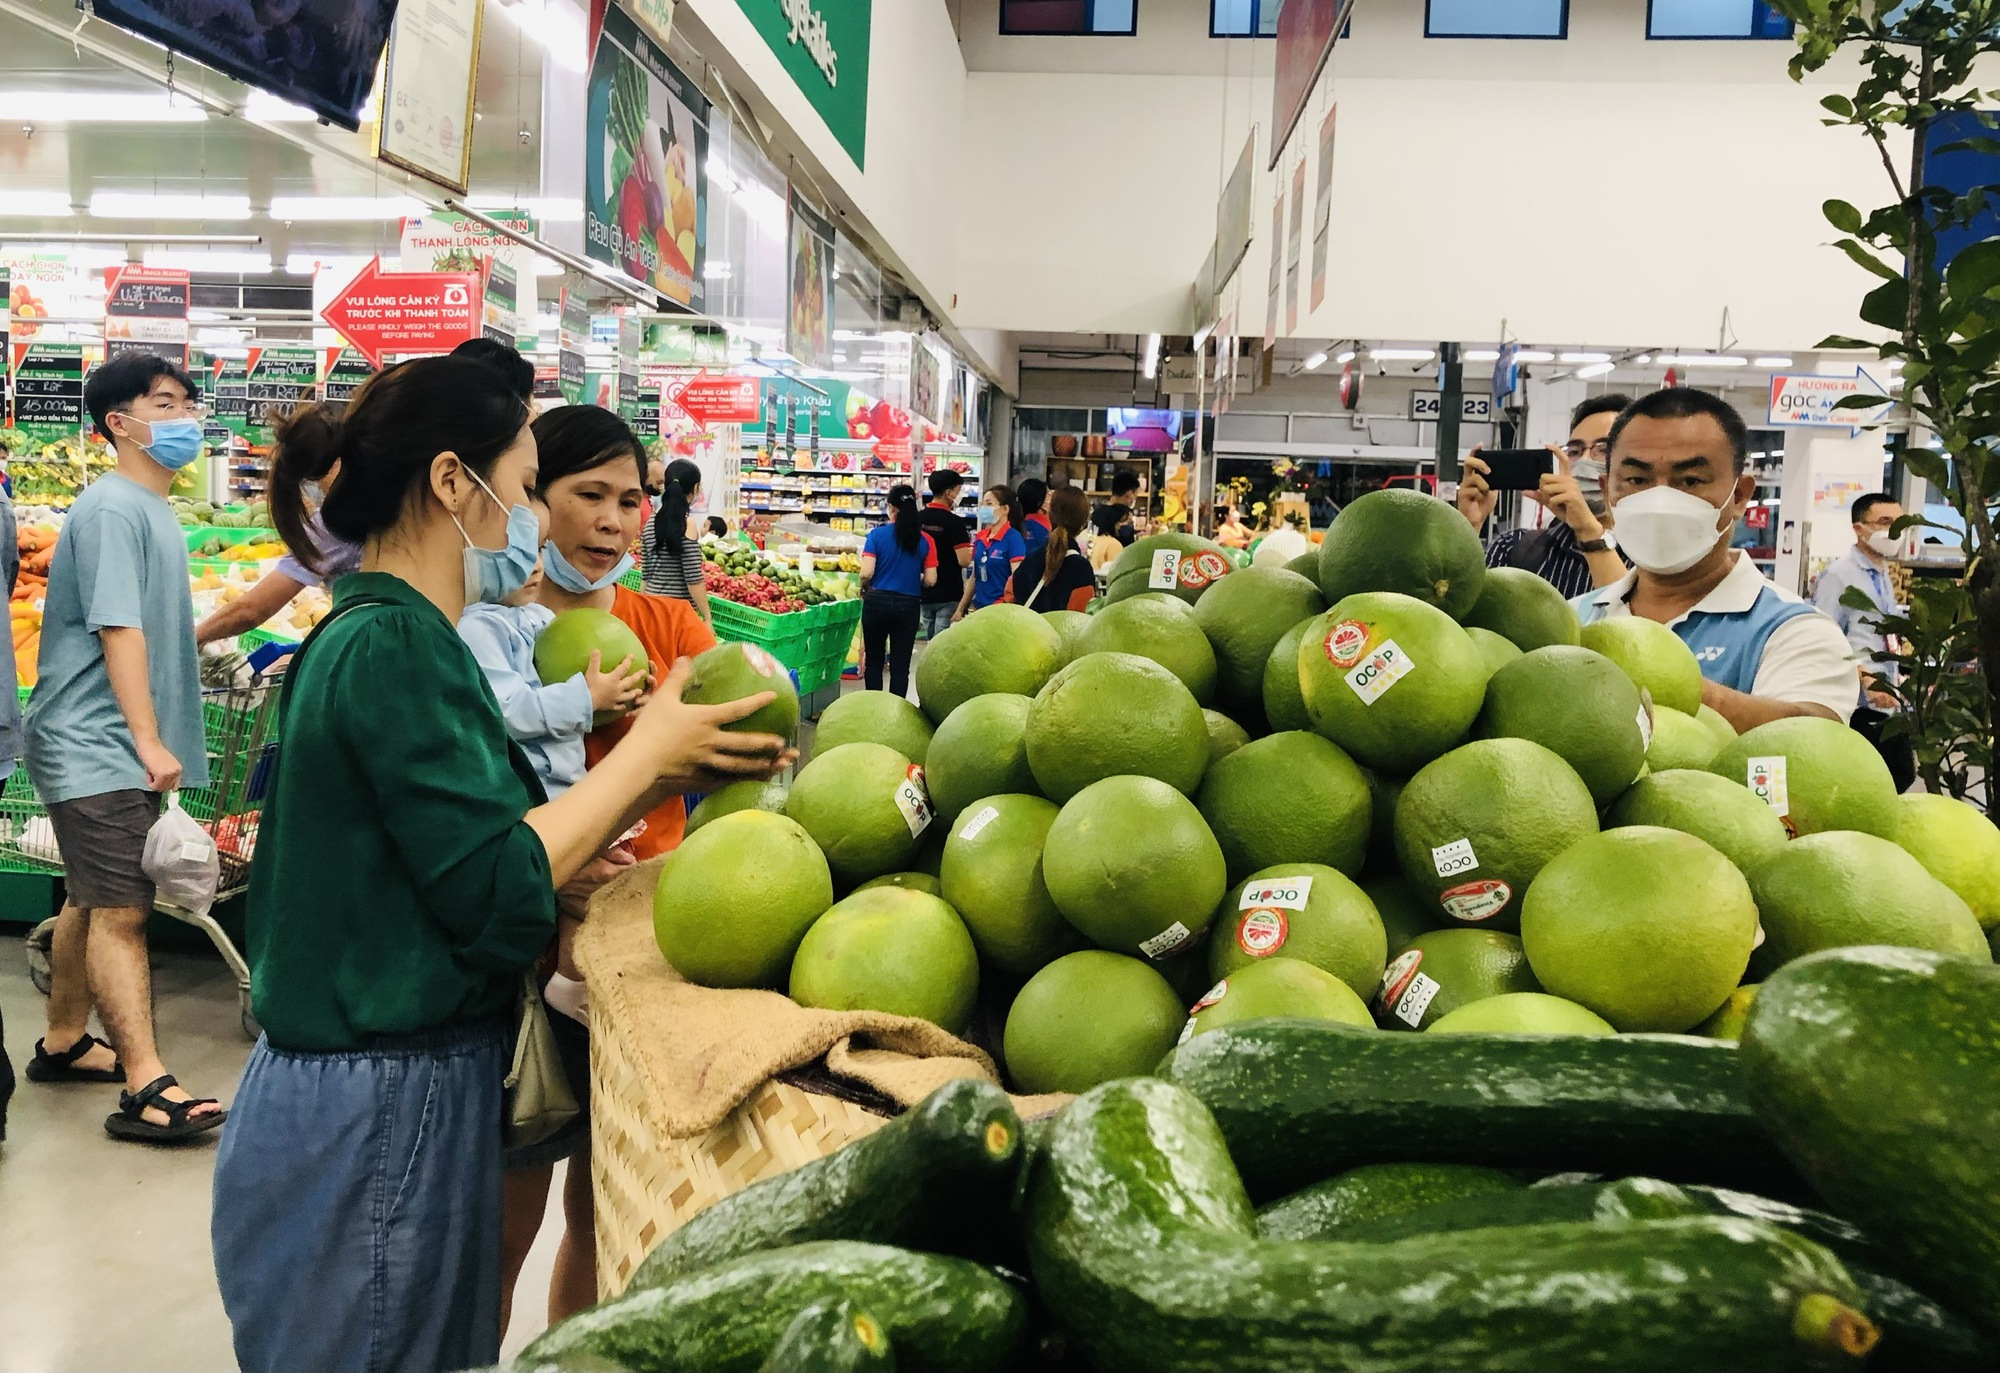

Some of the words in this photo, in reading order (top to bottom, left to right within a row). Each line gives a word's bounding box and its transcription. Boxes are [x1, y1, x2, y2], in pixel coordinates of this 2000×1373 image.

[411, 238, 453, 248] THANH
[588, 210, 609, 249] Rau
[624, 231, 637, 263] An
[36, 273, 65, 282] NGON
[345, 297, 365, 306] VUI
[366, 294, 397, 306] LÒNG
[346, 307, 383, 318] TRƯỚC
[384, 308, 401, 318] KHI
[404, 308, 439, 318] THANH
[441, 307, 469, 318] TOÁN
[347, 323, 377, 331] PLEASE
[377, 323, 401, 331] KINDLY
[427, 322, 441, 330] THE
[443, 322, 468, 330] GOODS
[381, 331, 409, 339] BEFORE
[411, 331, 435, 339] PAYING
[165, 356, 183, 365] VND
[1841, 381, 1858, 390] RA
[1415, 398, 1440, 414] 24
[1463, 400, 1489, 415] 23
[1780, 391, 1817, 412] góc
[1811, 413, 1829, 421] Deli
[1830, 414, 1860, 423] Corner
[1162, 553, 1175, 583] OCOP
[1355, 649, 1394, 686] OCOP
[904, 788, 926, 821] OCOP
[1248, 889, 1299, 903] OCOP
[1400, 977, 1423, 1014] OCOP
